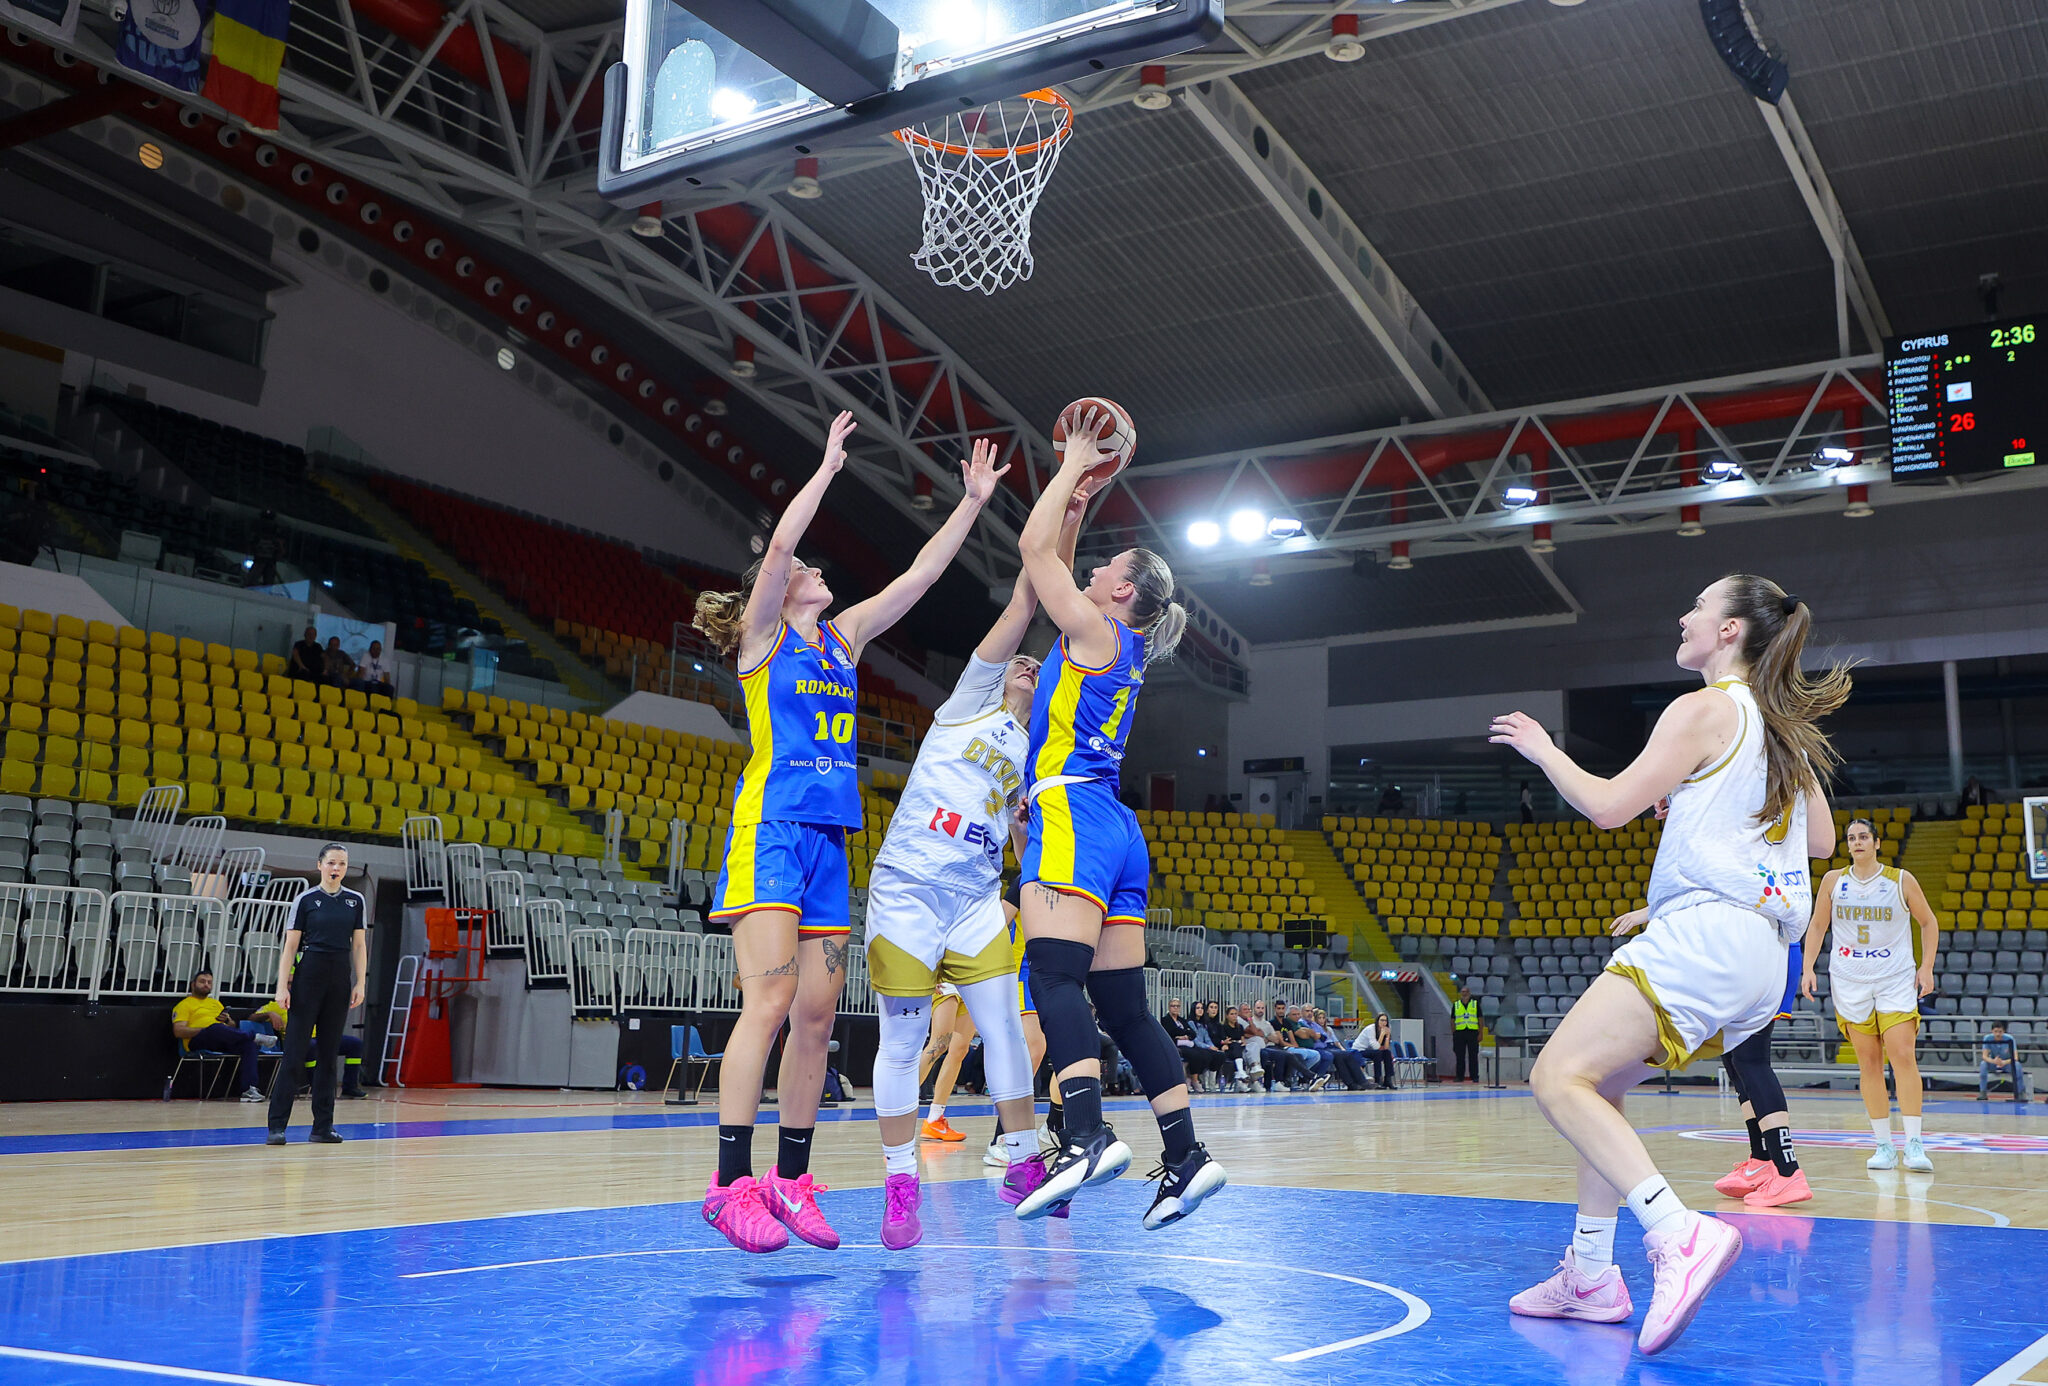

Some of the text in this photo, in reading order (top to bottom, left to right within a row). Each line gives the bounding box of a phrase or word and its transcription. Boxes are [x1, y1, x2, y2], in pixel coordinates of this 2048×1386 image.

[1901, 334, 1949, 352] CYPRUS
[1991, 324, 2036, 348] 2:36
[2007, 351, 2016, 362] 2
[1945, 360, 1953, 371] 2
[1950, 412, 1976, 433] 26
[2011, 438, 2026, 449] 10
[814, 711, 856, 744] 10
[1836, 905, 1893, 922] CYPRUS
[1857, 924, 1870, 945] 5
[1852, 948, 1891, 959] EKO
